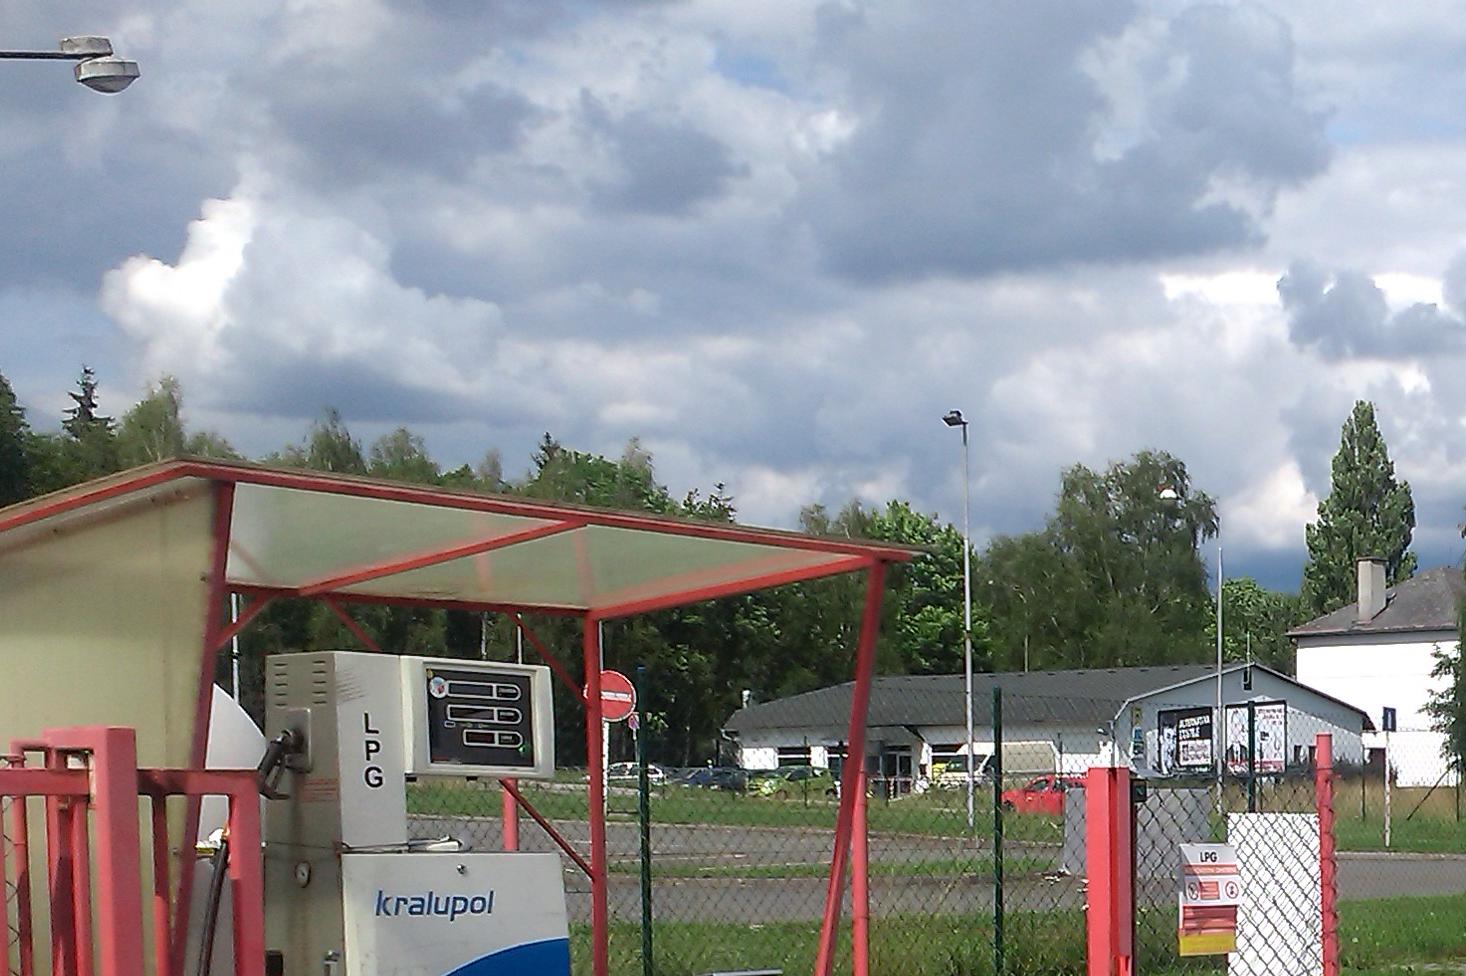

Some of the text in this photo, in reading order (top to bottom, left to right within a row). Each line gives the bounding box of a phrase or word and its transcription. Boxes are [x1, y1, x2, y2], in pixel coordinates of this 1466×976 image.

[363, 711, 383, 789] LPG
[1199, 851, 1218, 863] LPG
[375, 889, 494, 922] kralupol
